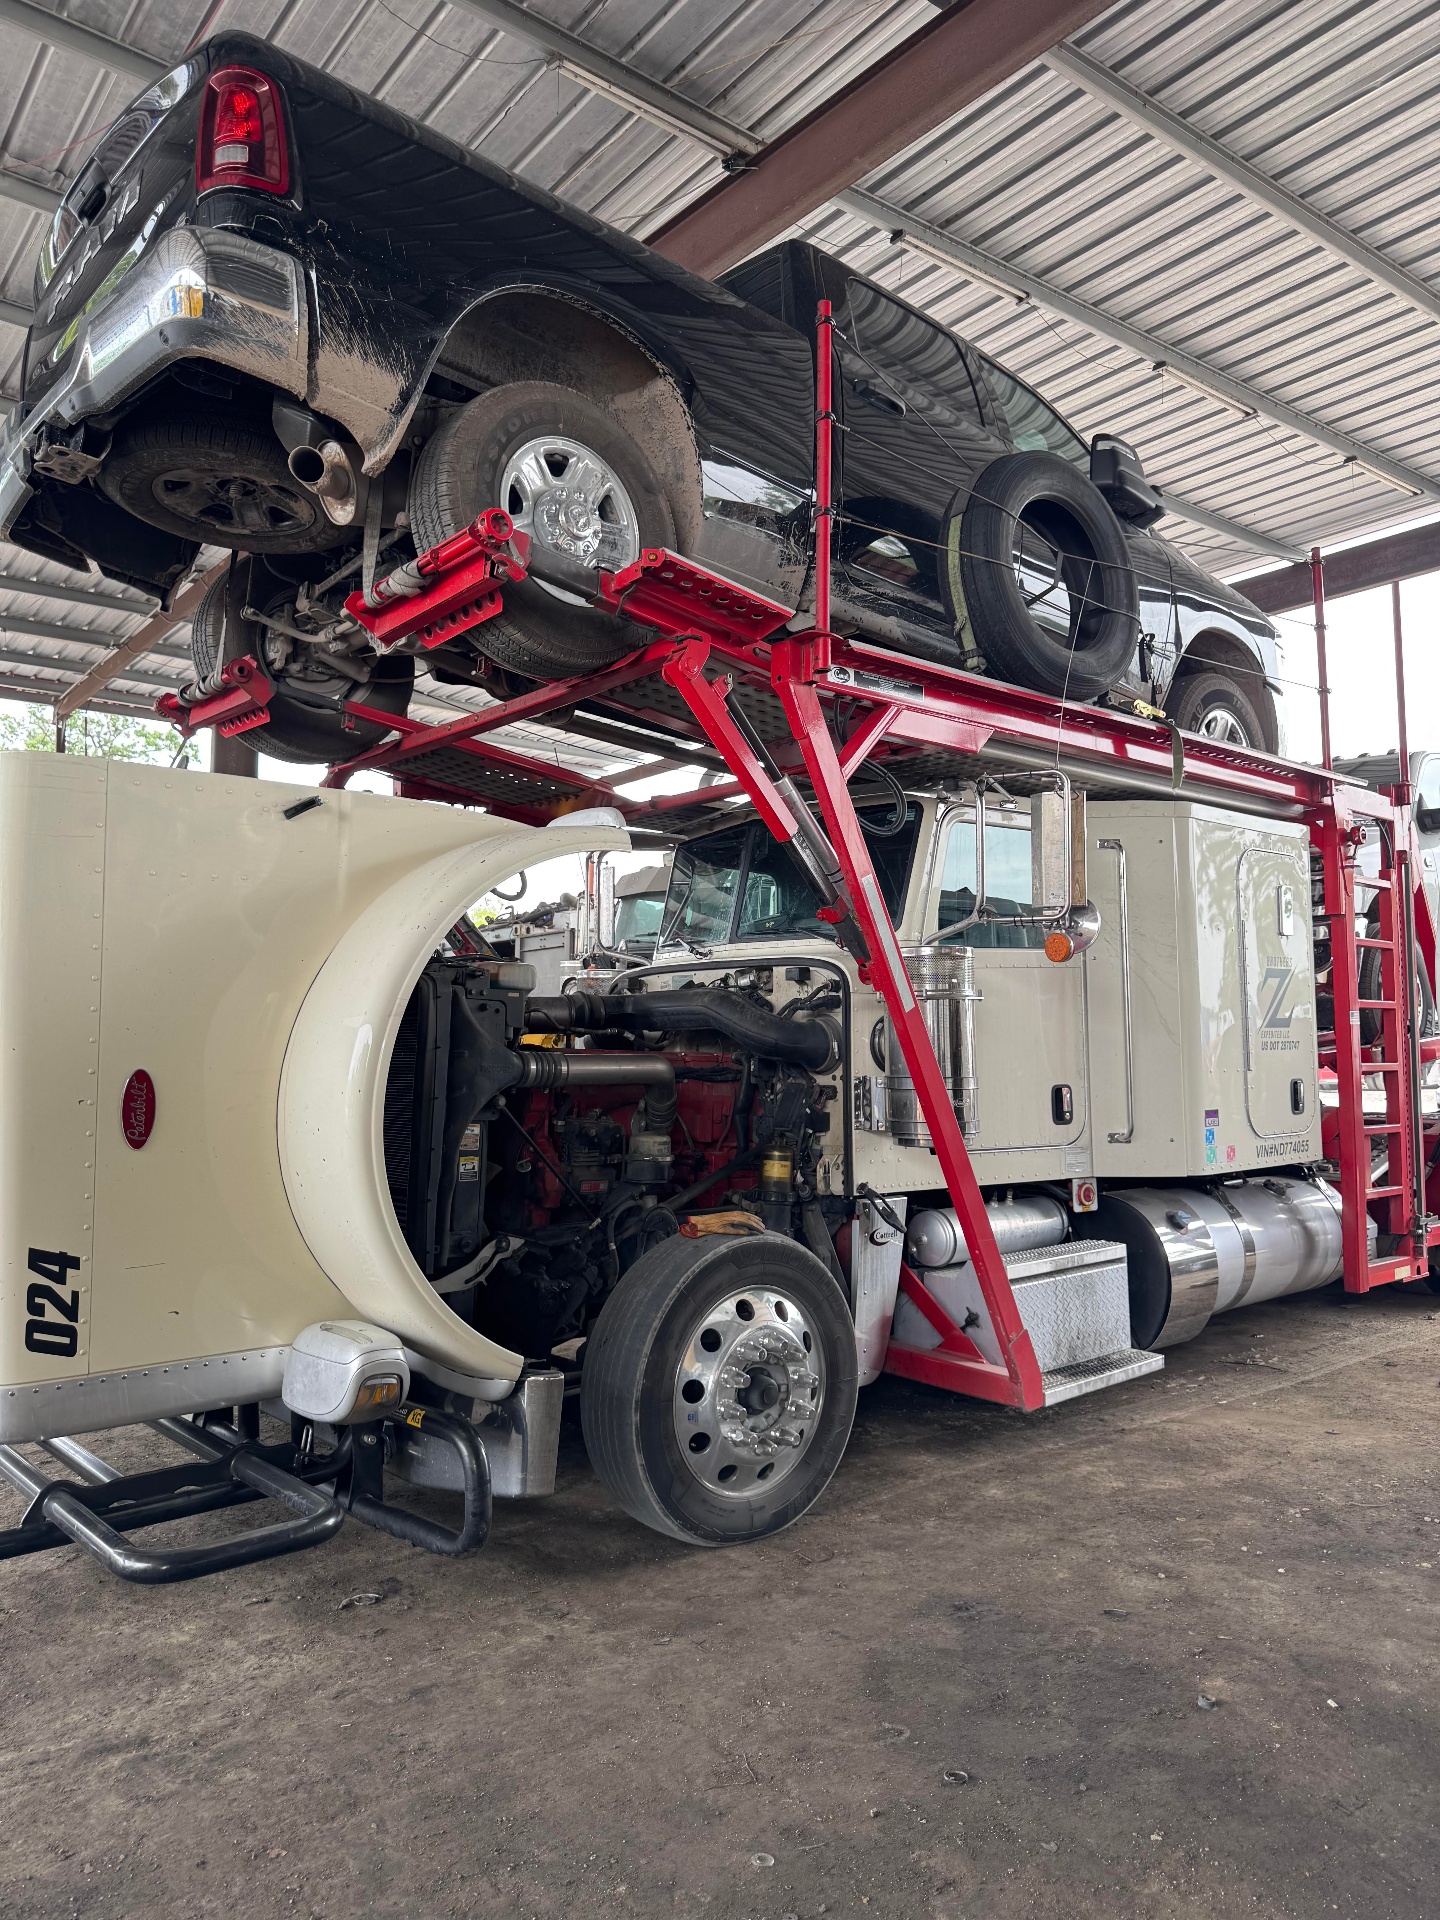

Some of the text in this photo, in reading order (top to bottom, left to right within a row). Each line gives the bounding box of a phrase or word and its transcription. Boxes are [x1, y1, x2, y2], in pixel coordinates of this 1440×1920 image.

[1261, 1041, 1269, 1051] US
[1269, 1041, 1280, 1051] DOT
[126, 1076, 147, 1141] Peterbilt
[875, 1230, 898, 1240] Cottrell
[25, 1247, 80, 1357] 024
